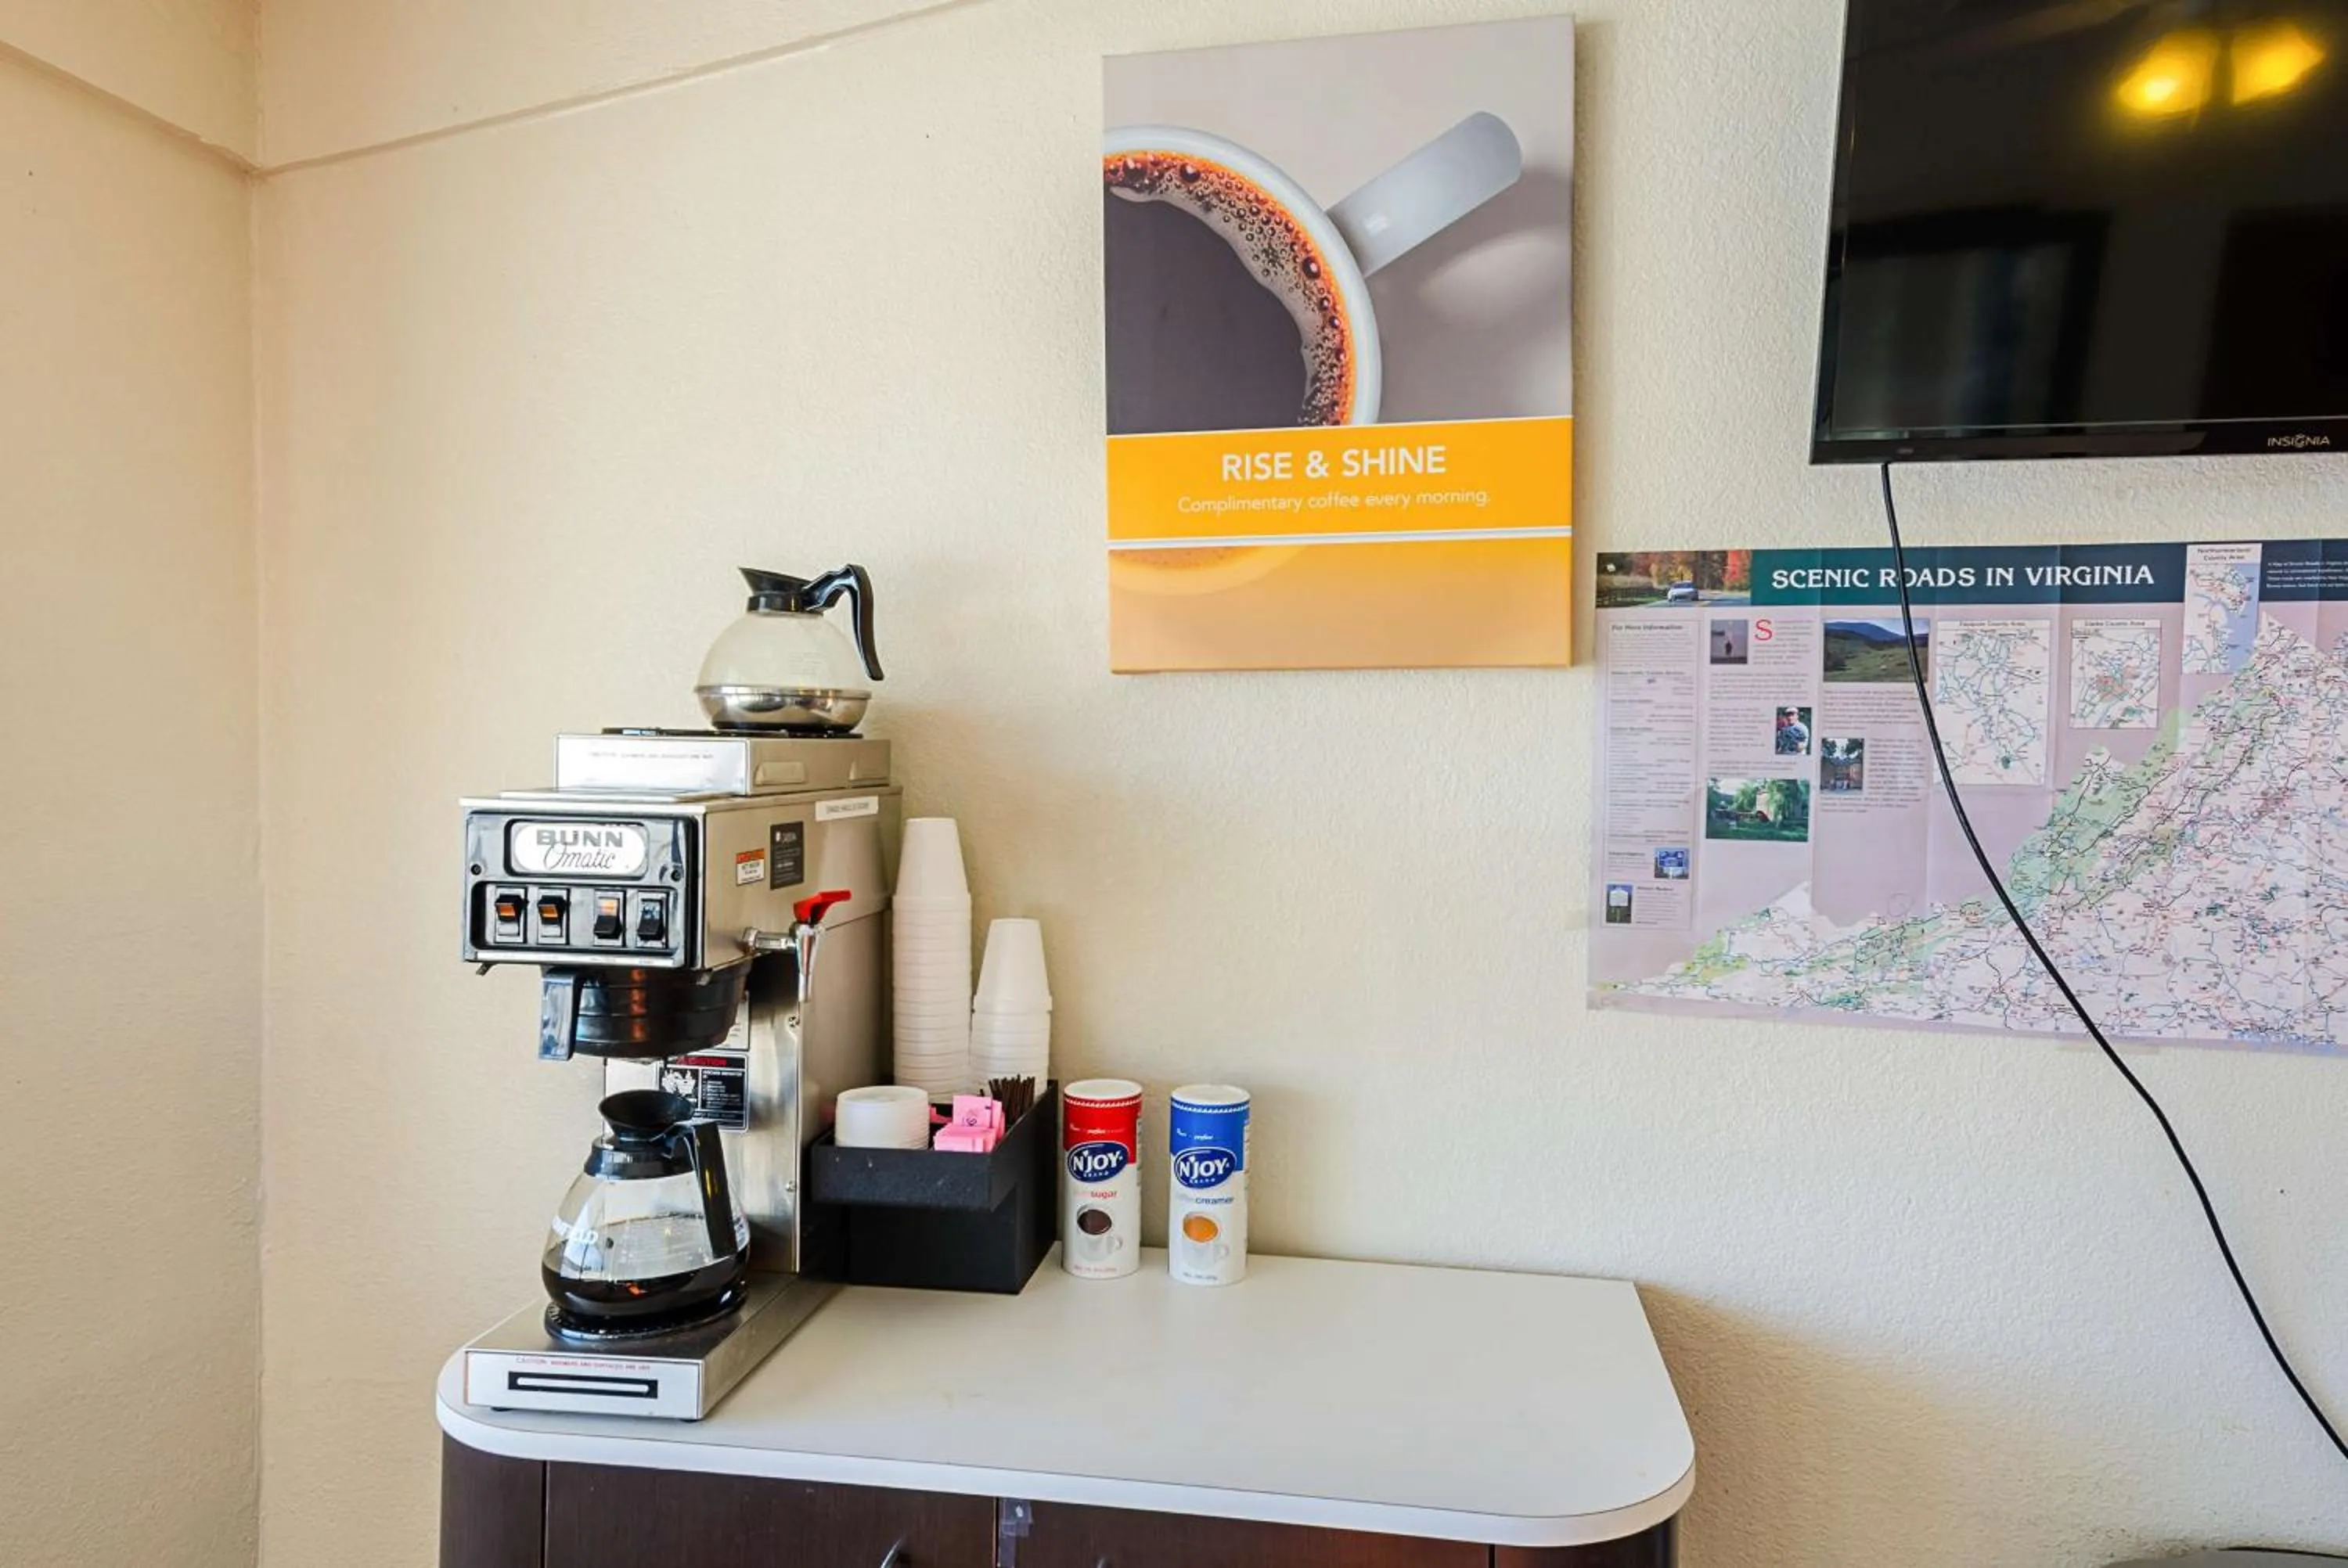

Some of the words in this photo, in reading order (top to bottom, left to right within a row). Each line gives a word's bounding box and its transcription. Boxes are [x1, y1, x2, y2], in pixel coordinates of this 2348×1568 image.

[2267, 433, 2331, 448] INSIGNIA
[1222, 451, 1293, 481] RISE
[1305, 450, 1330, 479] &
[1341, 445, 1447, 477] SHINE
[1177, 494, 1302, 518] Complimentary
[1308, 491, 1359, 509] coffee
[1365, 493, 1410, 509] every
[1416, 488, 1491, 507] morning.
[1771, 568, 1870, 589] SCENIC
[1879, 566, 1976, 588] ROADS
[1986, 567, 2015, 587] IN
[2024, 564, 2155, 587] VIRGINIA
[536, 829, 624, 847] BUNN
